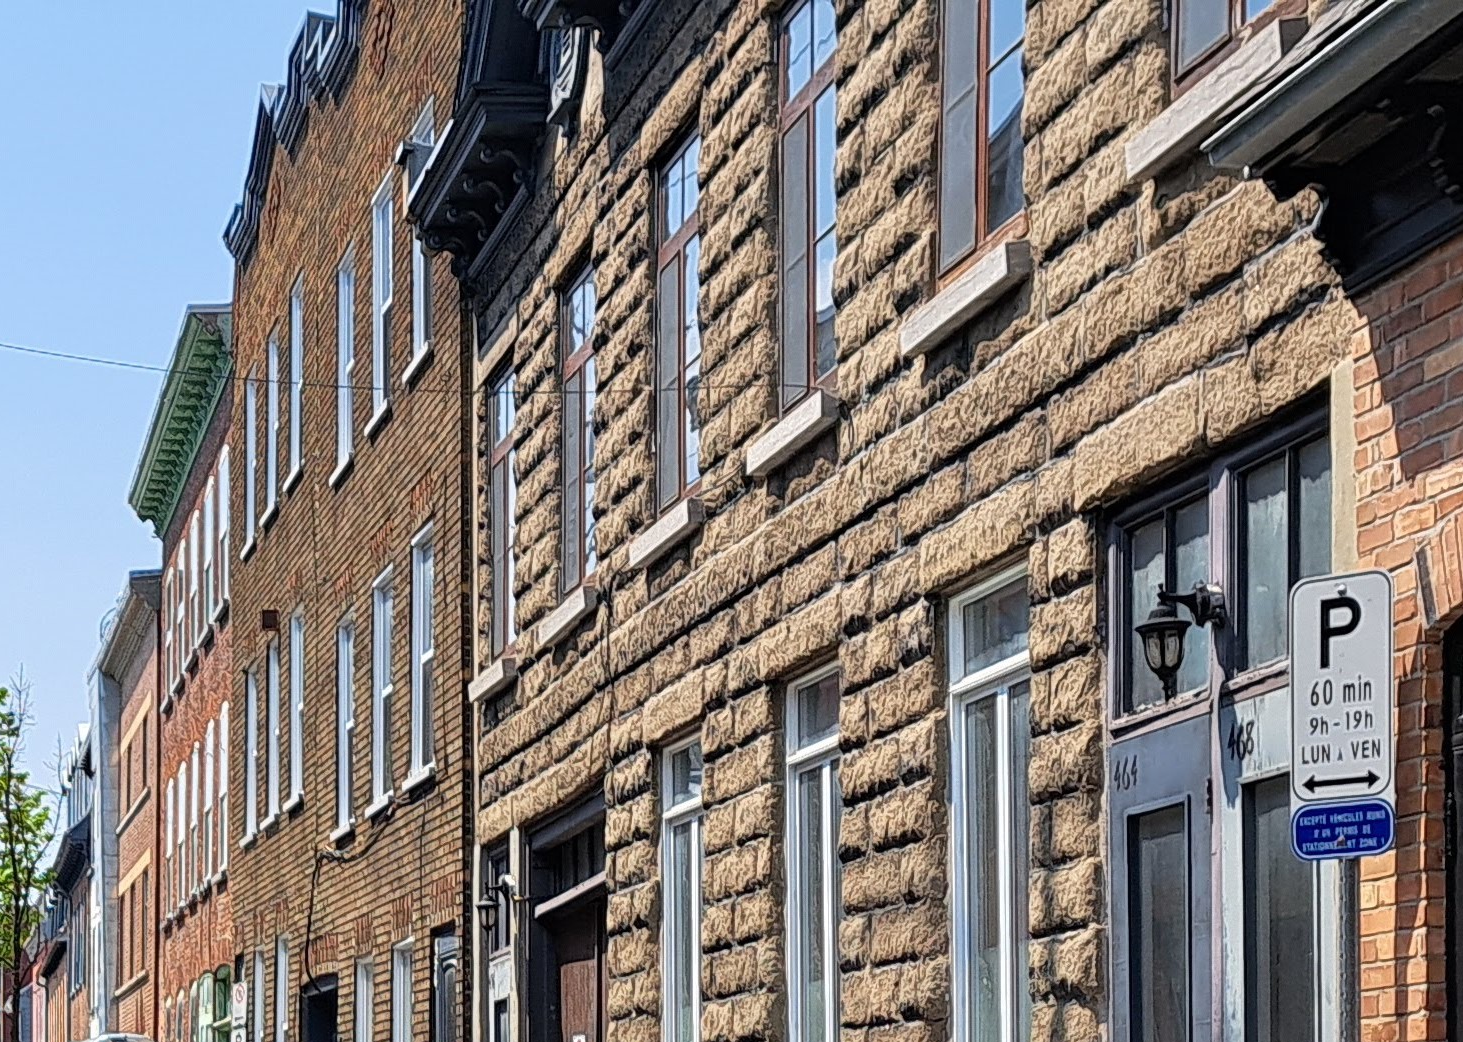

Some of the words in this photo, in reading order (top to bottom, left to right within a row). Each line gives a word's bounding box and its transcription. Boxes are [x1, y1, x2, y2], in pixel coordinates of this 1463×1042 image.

[1320, 596, 1362, 669] P
[1310, 678, 1333, 706] 60
[1342, 674, 1372, 703] min
[1227, 719, 1255, 761] 468
[1301, 743, 1331, 764] LUN
[1350, 738, 1381, 760] VEN
